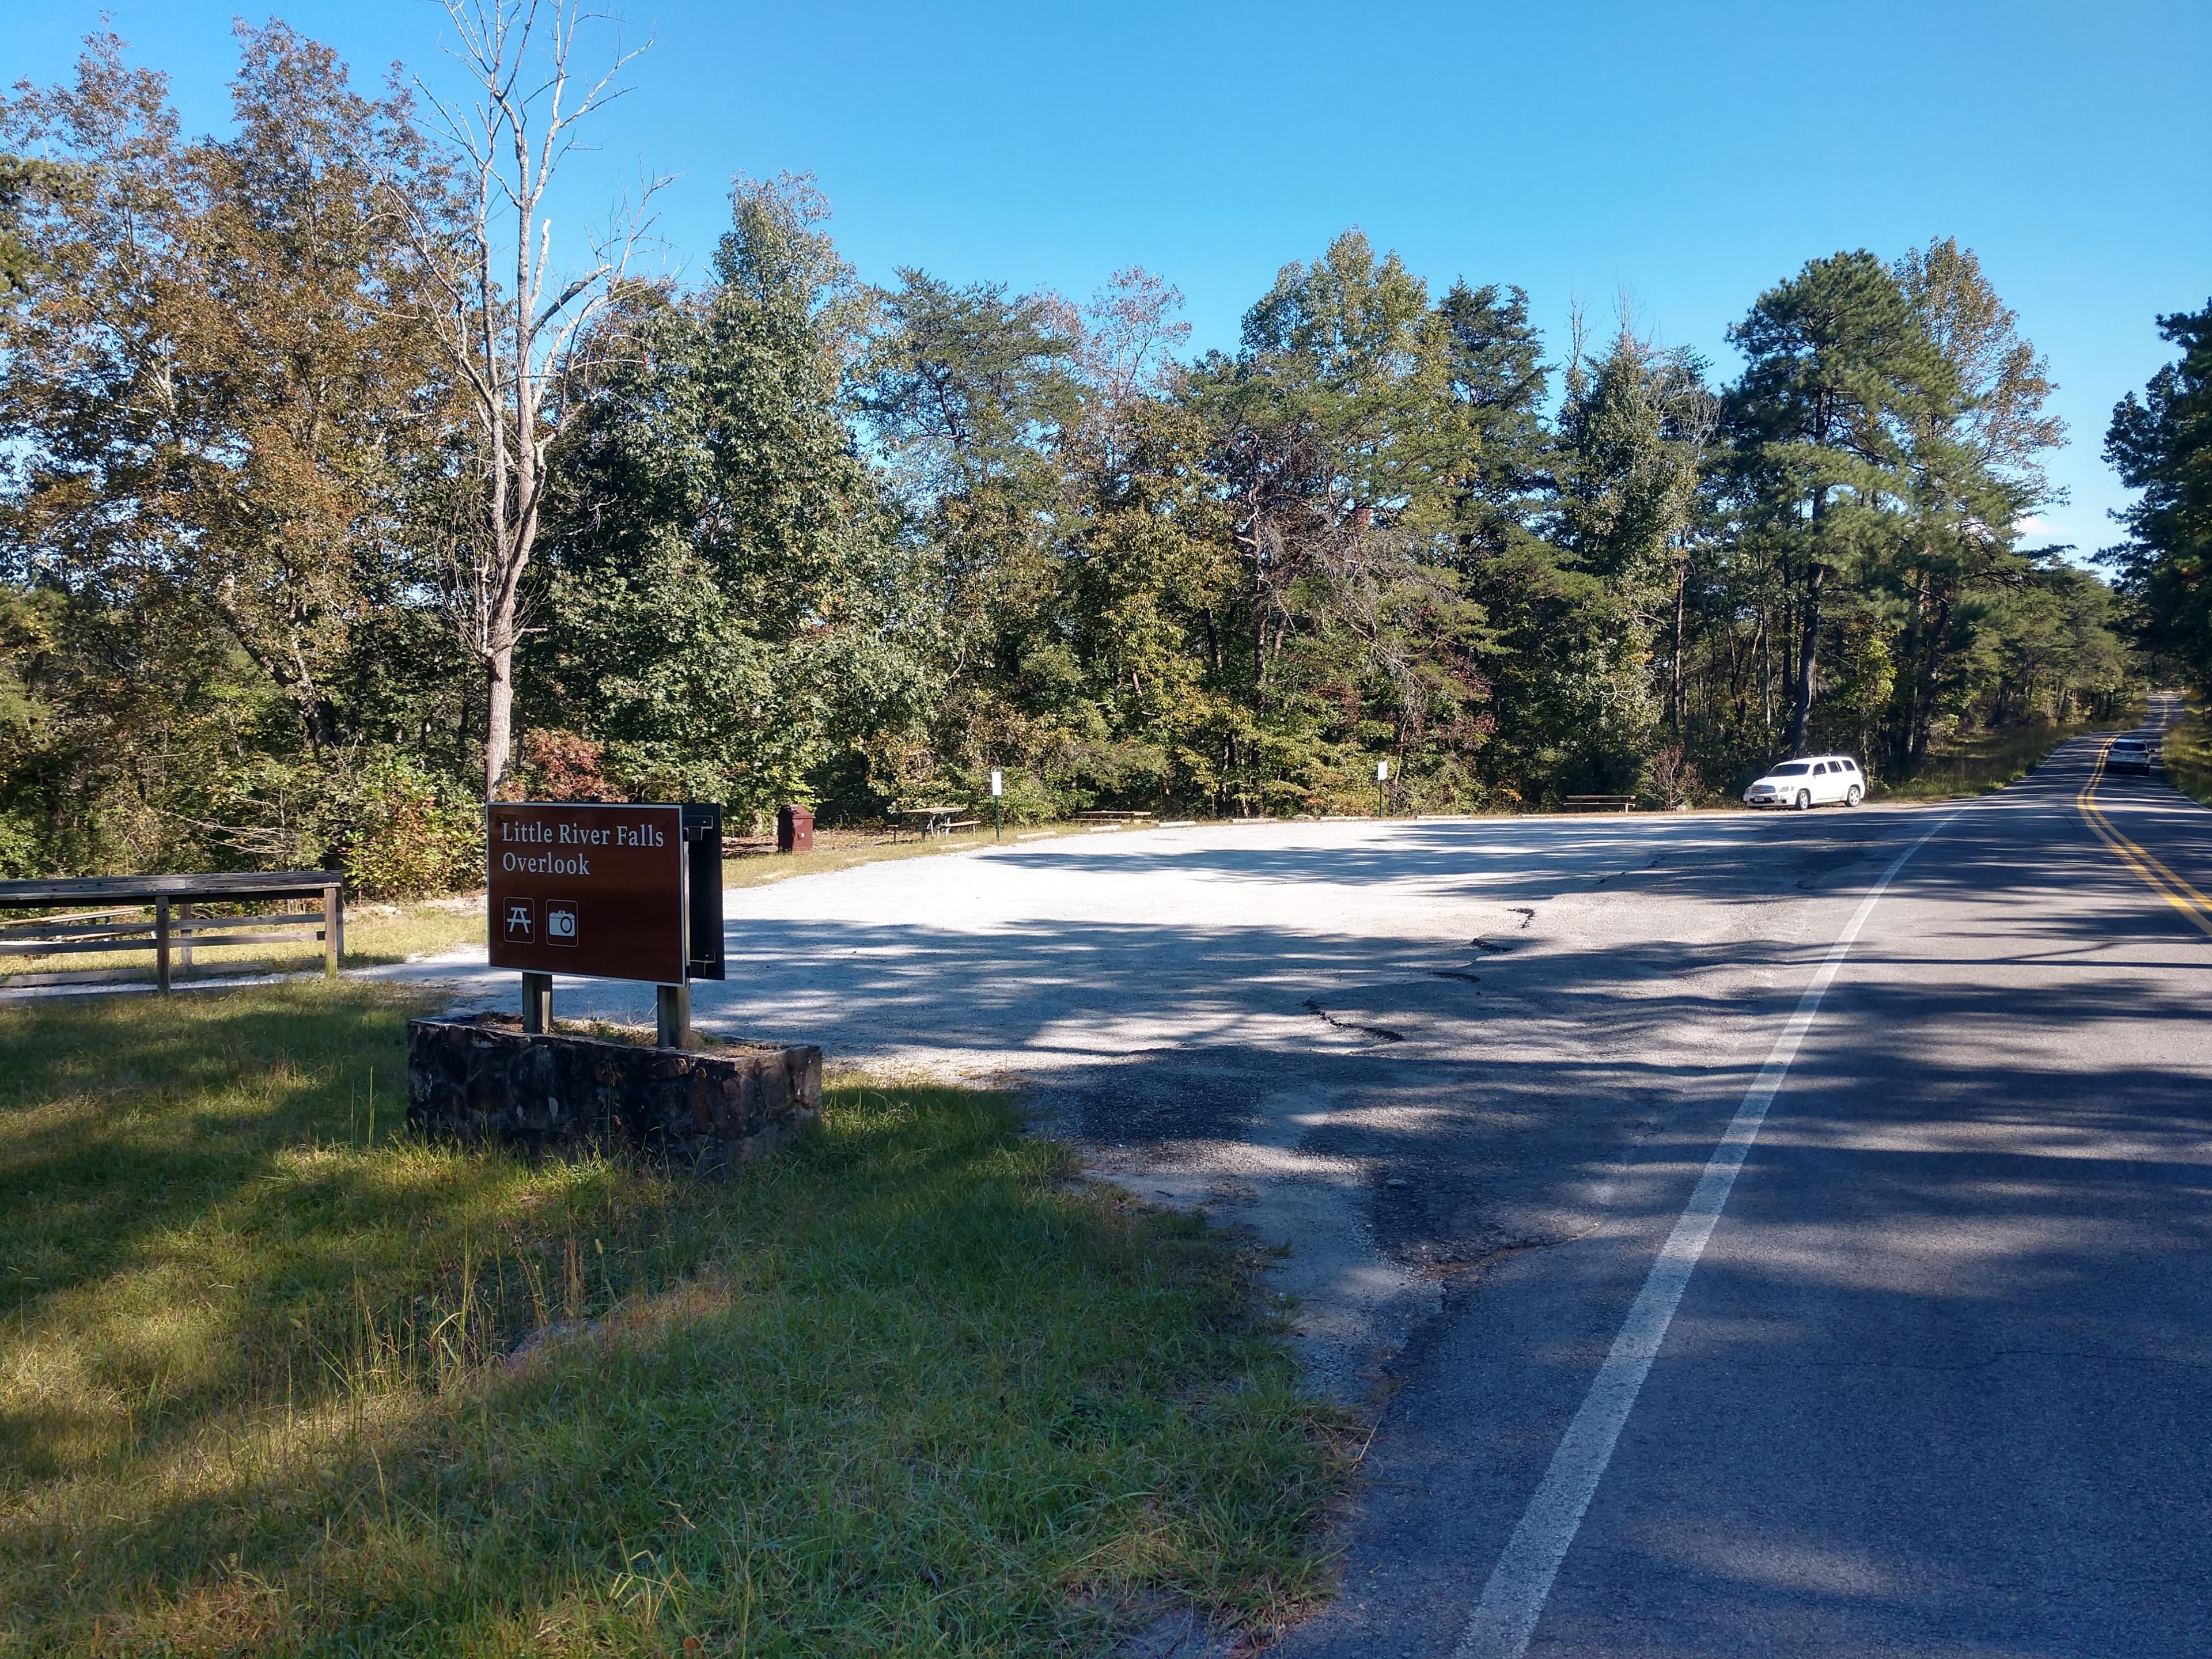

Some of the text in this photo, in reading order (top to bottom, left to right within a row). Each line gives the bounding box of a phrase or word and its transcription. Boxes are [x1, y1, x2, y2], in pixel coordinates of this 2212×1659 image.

[502, 821, 664, 847] Little River Falls
[502, 851, 590, 875] Overlook
